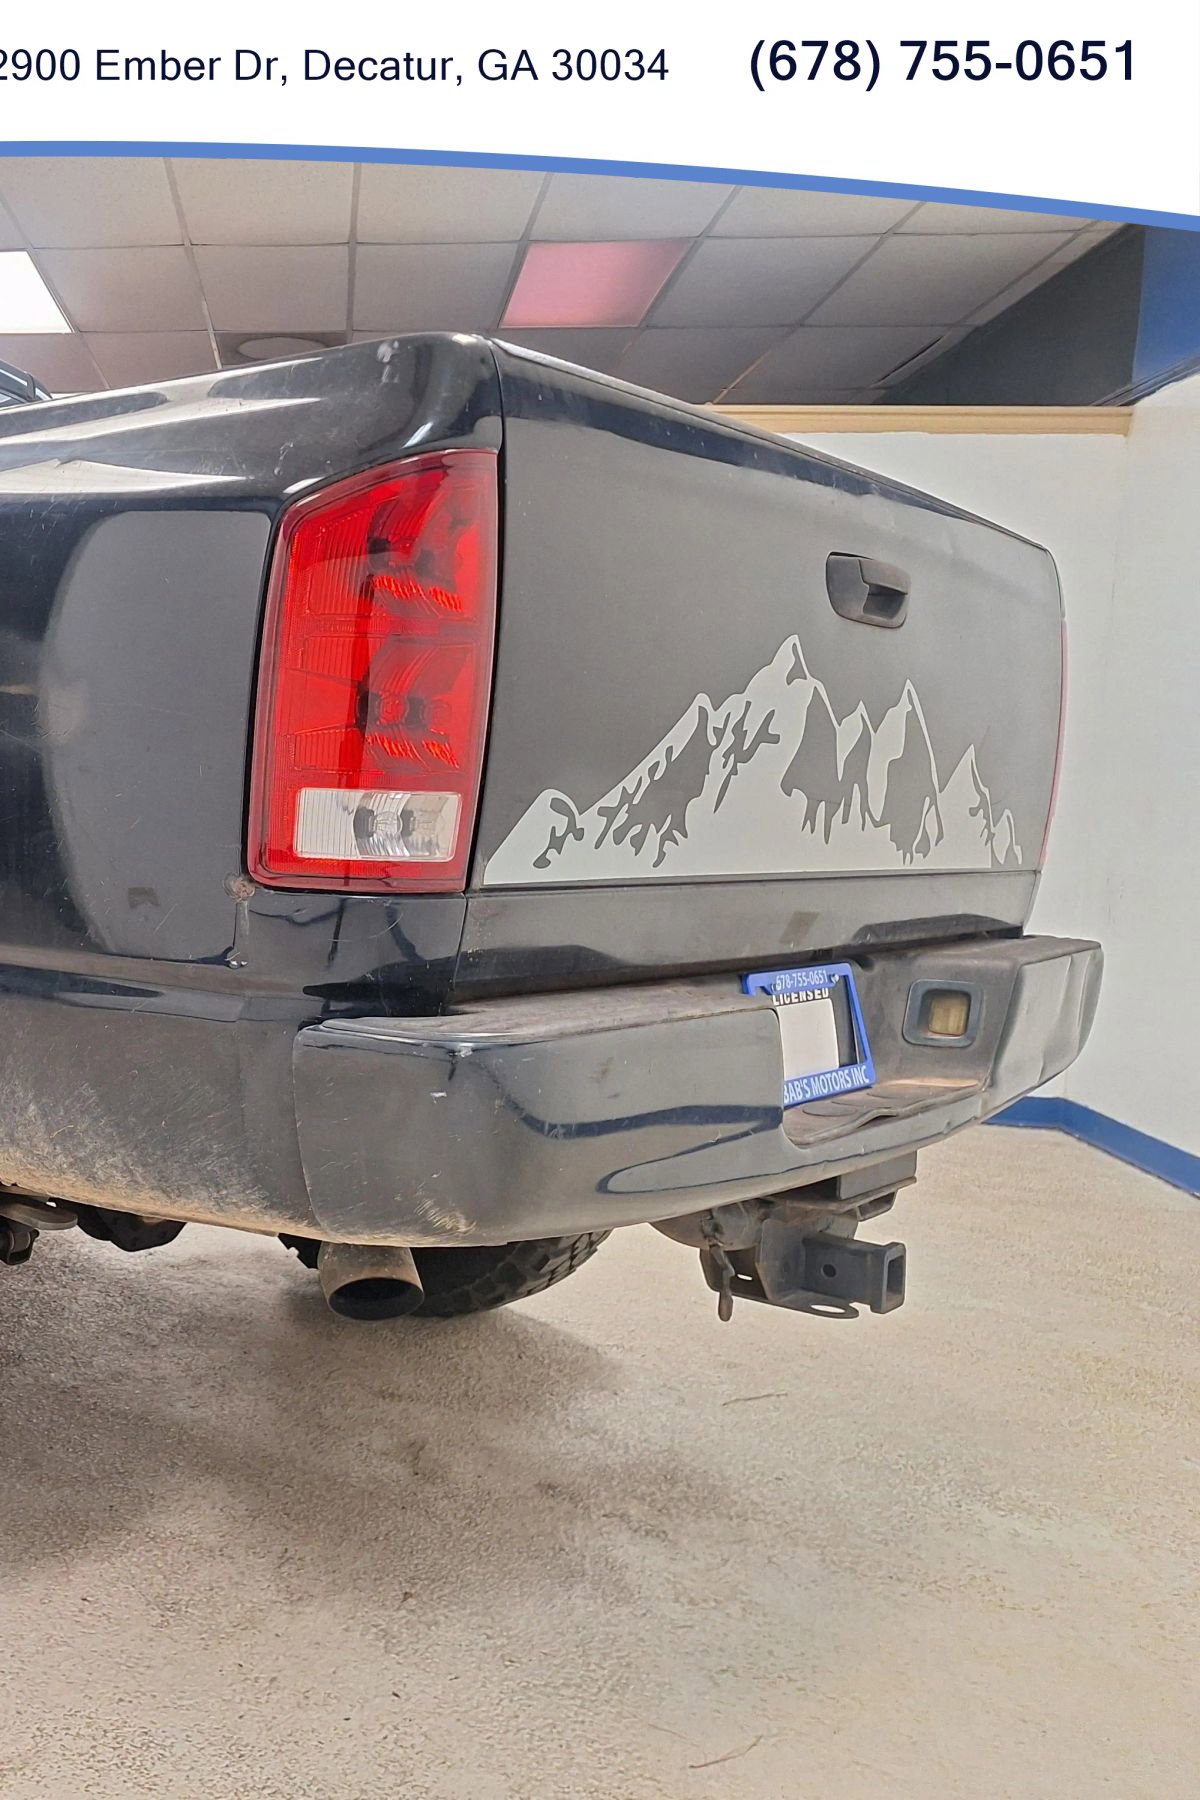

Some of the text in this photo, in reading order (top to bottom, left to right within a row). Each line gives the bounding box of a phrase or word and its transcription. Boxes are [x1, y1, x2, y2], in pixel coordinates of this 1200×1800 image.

[775, 970, 829, 991] 678-755-0651
[772, 987, 829, 1006] LICENSED
[811, 1070, 852, 1097] MOTORS
[850, 1065, 870, 1087] INC
